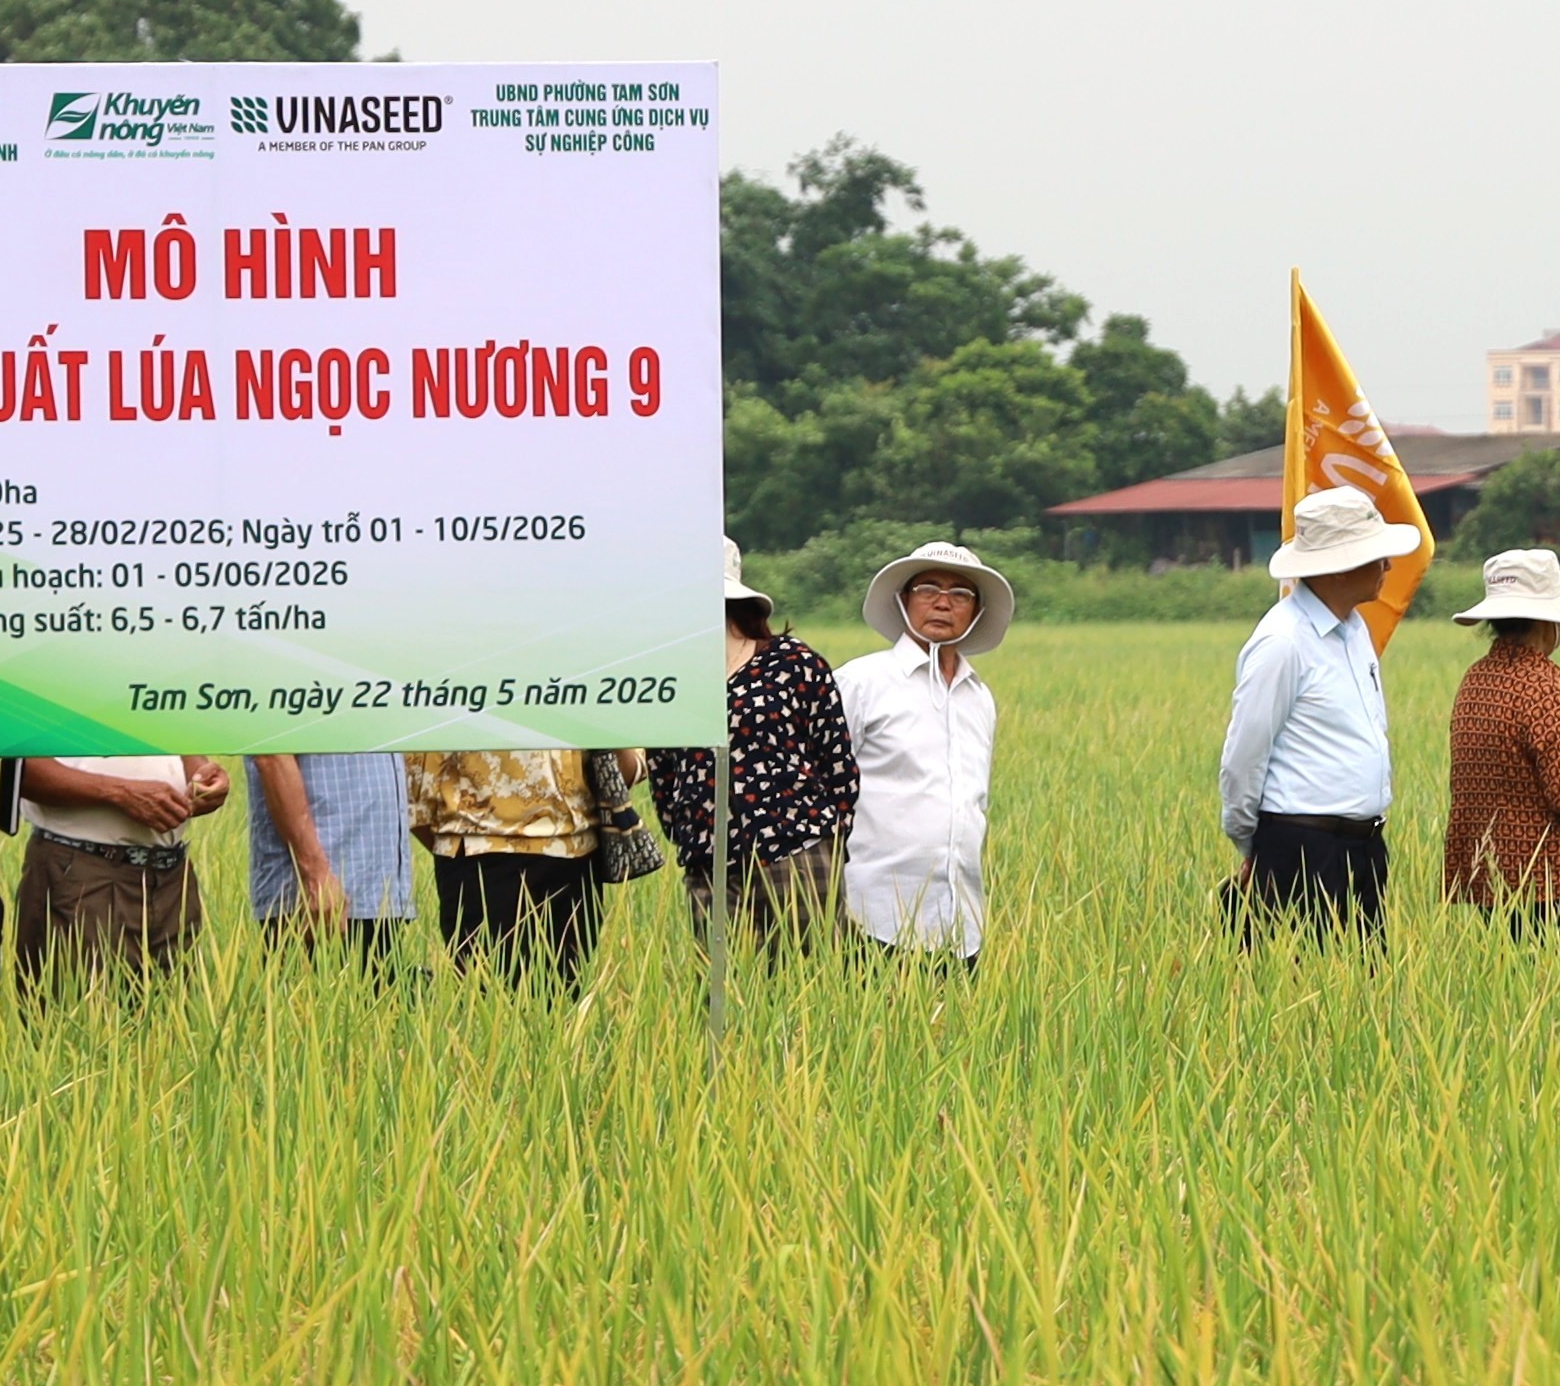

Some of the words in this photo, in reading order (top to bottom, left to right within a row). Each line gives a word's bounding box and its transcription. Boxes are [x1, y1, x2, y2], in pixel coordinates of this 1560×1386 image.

[102, 92, 200, 122] Khuyến
[495, 83, 539, 103] UBND
[543, 79, 608, 103] PHƯỜNG
[610, 83, 643, 102] TAM
[647, 81, 680, 102] SƠN
[275, 95, 443, 134] VINASEED
[469, 108, 522, 128] TRUNG
[525, 104, 560, 128] TÂM
[564, 108, 608, 128] CUNG
[611, 104, 644, 128] ỨNG
[648, 107, 685, 131] DỊCH
[688, 107, 710, 131] VỤ
[98, 118, 165, 147] nông
[189, 122, 215, 134] Nam
[257, 141, 267, 152] A
[268, 140, 317, 152] MEMBER
[318, 140, 334, 152] OF
[336, 140, 360, 152] THE
[361, 140, 386, 152] PAN
[387, 140, 427, 152] GROUP
[524, 131, 548, 157] SỰ
[550, 129, 608, 156] NGHIỆP
[612, 129, 655, 152] CÔNG
[83, 212, 197, 301] MÔ
[223, 211, 397, 300] HÌNH
[108, 333, 217, 422] LÚA
[234, 347, 391, 437] NGỌC
[411, 338, 609, 420] NƯƠNG
[628, 345, 661, 418] 9
[51, 518, 234, 550] 28/02/2026;
[242, 518, 314, 551] Ngày
[320, 511, 362, 544] trỗ
[369, 516, 402, 543] 01
[434, 514, 586, 543] 10/5/2026
[12, 562, 103, 595] hoạch:
[111, 562, 144, 589] 01
[174, 560, 349, 588] 05/06/2026
[33, 601, 102, 634] suất:
[110, 606, 155, 636] 6,5
[181, 605, 226, 635] 6,7
[234, 599, 326, 632] tấn/ha
[128, 683, 187, 712] Tam
[195, 682, 259, 714] Sơn,
[268, 680, 345, 716] ngày
[350, 680, 393, 709] 22
[401, 678, 488, 714] tháng
[495, 678, 517, 706] 5
[523, 676, 588, 706] năm
[596, 676, 678, 705] 2026
